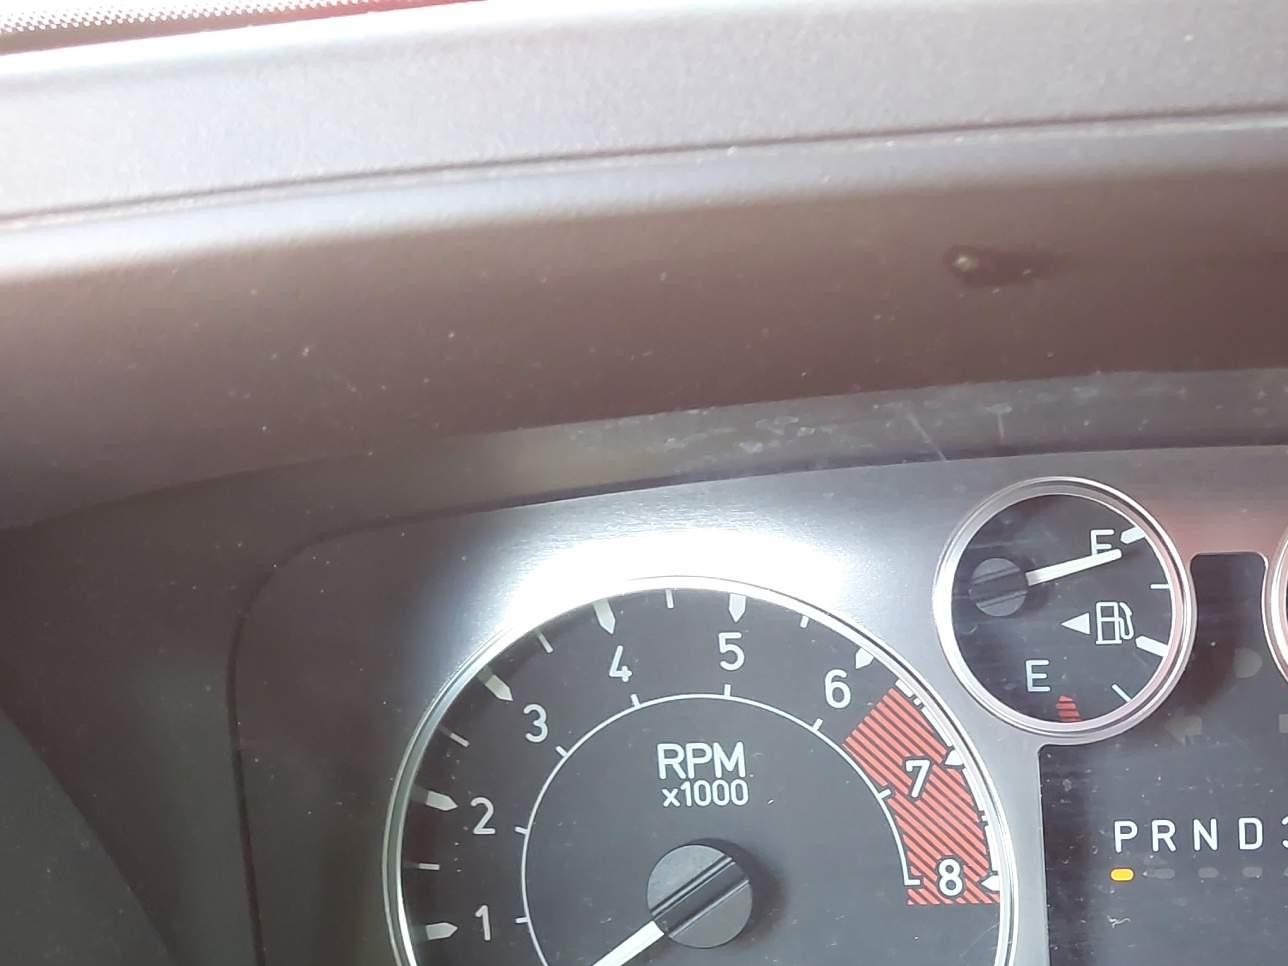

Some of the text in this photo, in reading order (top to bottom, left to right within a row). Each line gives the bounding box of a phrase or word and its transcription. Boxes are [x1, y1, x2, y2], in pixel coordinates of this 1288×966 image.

[609, 645, 633, 682] 4
[719, 632, 745, 671] 5
[824, 670, 852, 708] 6
[1025, 659, 1050, 692] E
[523, 704, 548, 742] 3
[657, 742, 746, 779] RPM
[905, 759, 932, 799] 7
[661, 780, 749, 807] x1000
[472, 798, 496, 835] 2
[1114, 821, 1138, 853] P
[1152, 819, 1176, 852] R
[1193, 818, 1218, 851] N
[1238, 817, 1263, 850] D
[937, 858, 964, 897] 8
[475, 905, 492, 941] 1
